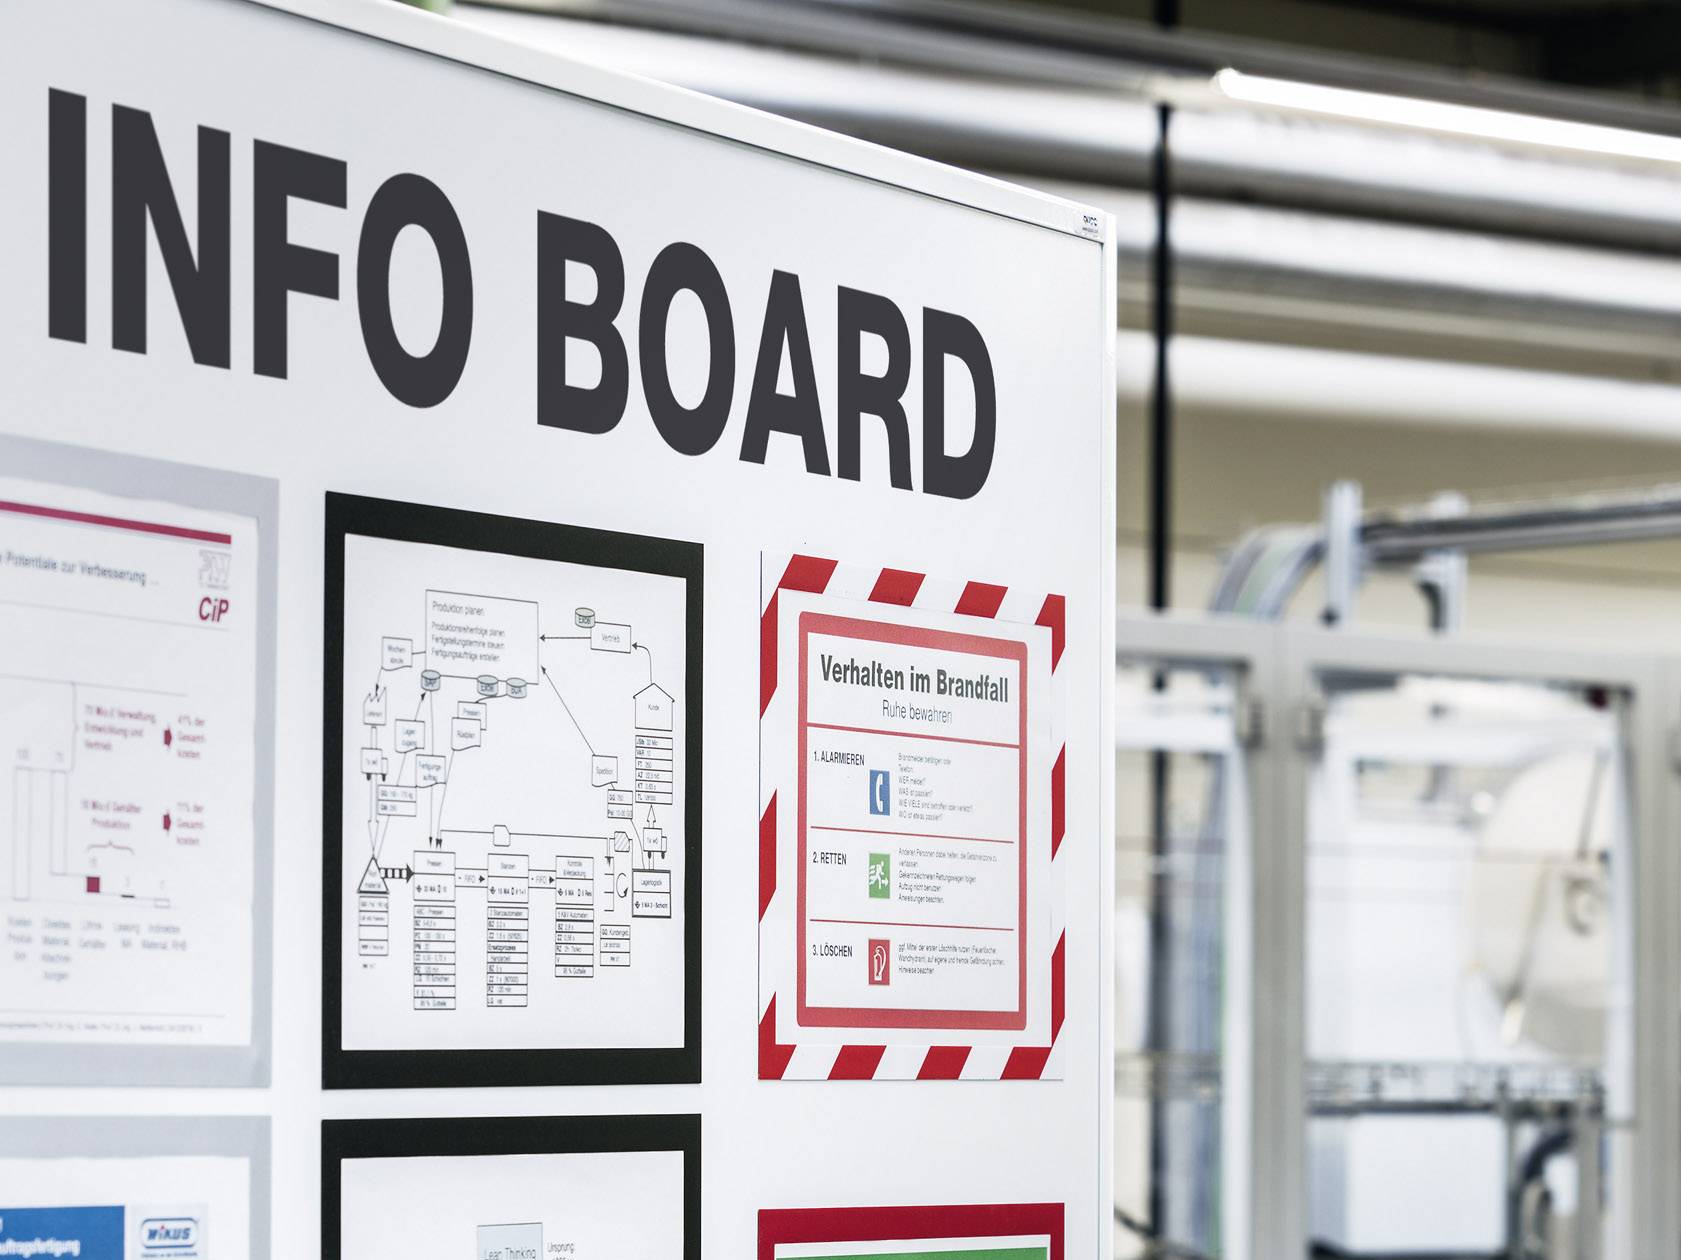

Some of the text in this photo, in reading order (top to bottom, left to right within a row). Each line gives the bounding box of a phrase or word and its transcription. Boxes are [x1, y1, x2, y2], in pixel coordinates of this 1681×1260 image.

[48, 87, 997, 501] INFO BOARD
[198, 597, 229, 623] CiP
[820, 653, 1009, 703] Verhalten im Brandfall
[882, 699, 953, 724] Ruhe bewahren
[813, 751, 865, 766] 1. ALARMIEREN
[812, 852, 847, 865] 2. RETTEN
[812, 943, 853, 958] 3. LÖSCHEN
